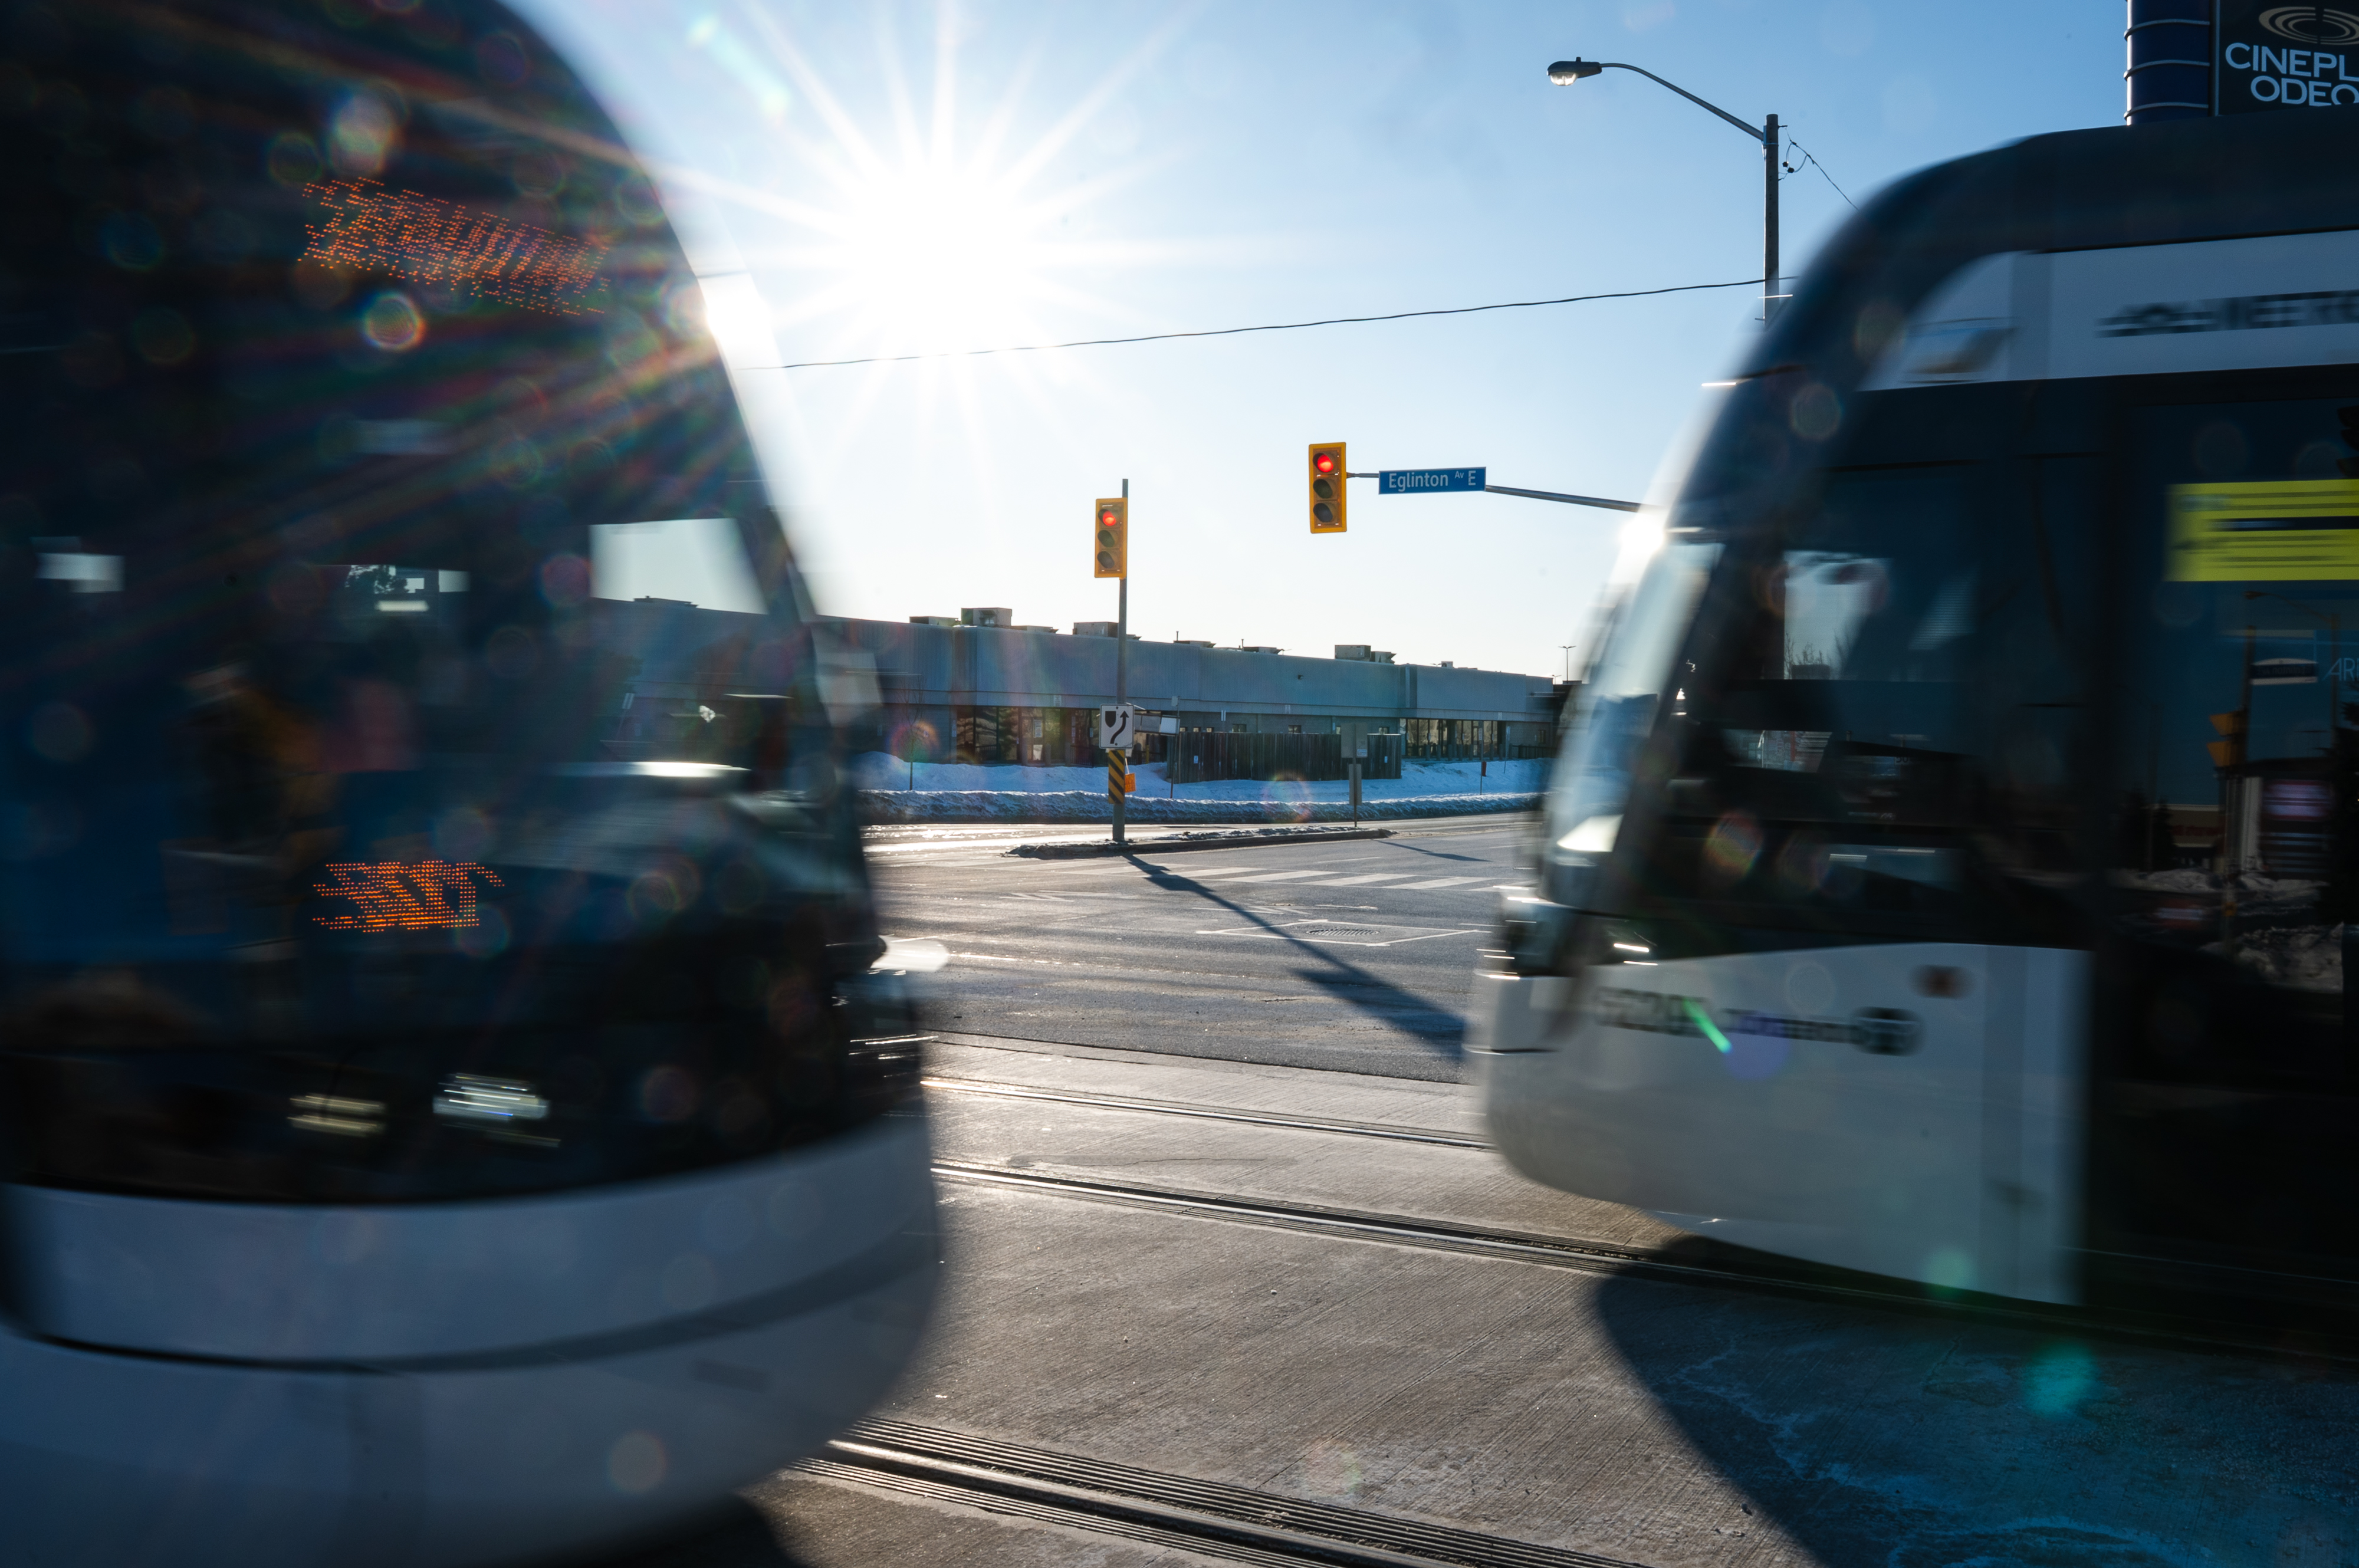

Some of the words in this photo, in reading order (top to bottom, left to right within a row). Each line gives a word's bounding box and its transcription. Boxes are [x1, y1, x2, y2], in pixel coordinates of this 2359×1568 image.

[2225, 42, 2359, 82] CINEPL
[1389, 472, 1448, 492] Eglinton
[1454, 471, 1464, 479] Av
[1468, 471, 1476, 486] E
